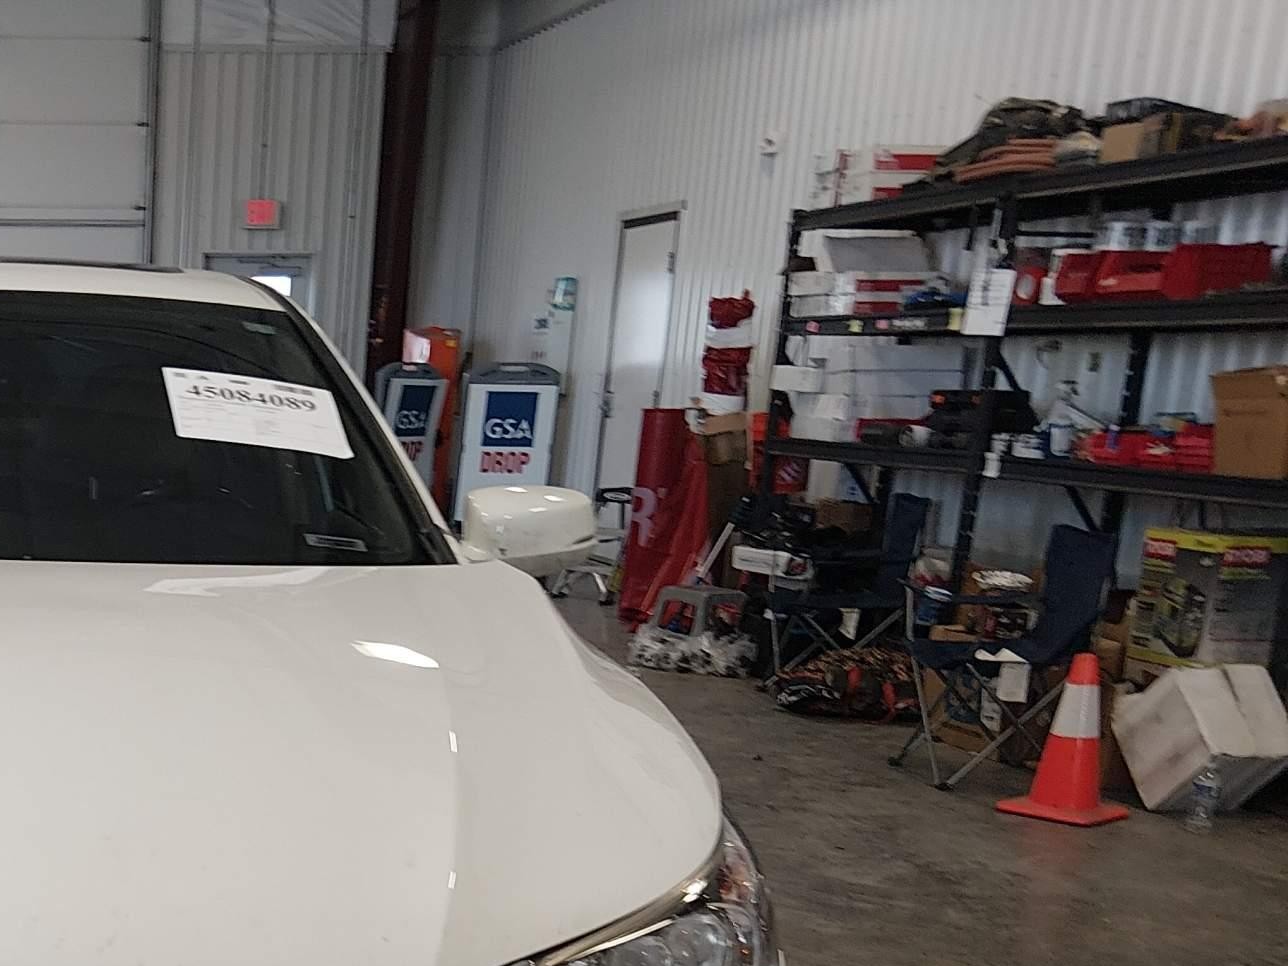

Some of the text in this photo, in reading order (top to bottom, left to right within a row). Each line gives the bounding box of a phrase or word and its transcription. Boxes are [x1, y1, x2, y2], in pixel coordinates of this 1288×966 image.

[186, 384, 317, 412] 45084089
[485, 417, 533, 440] GSA
[479, 451, 530, 474] DROP
